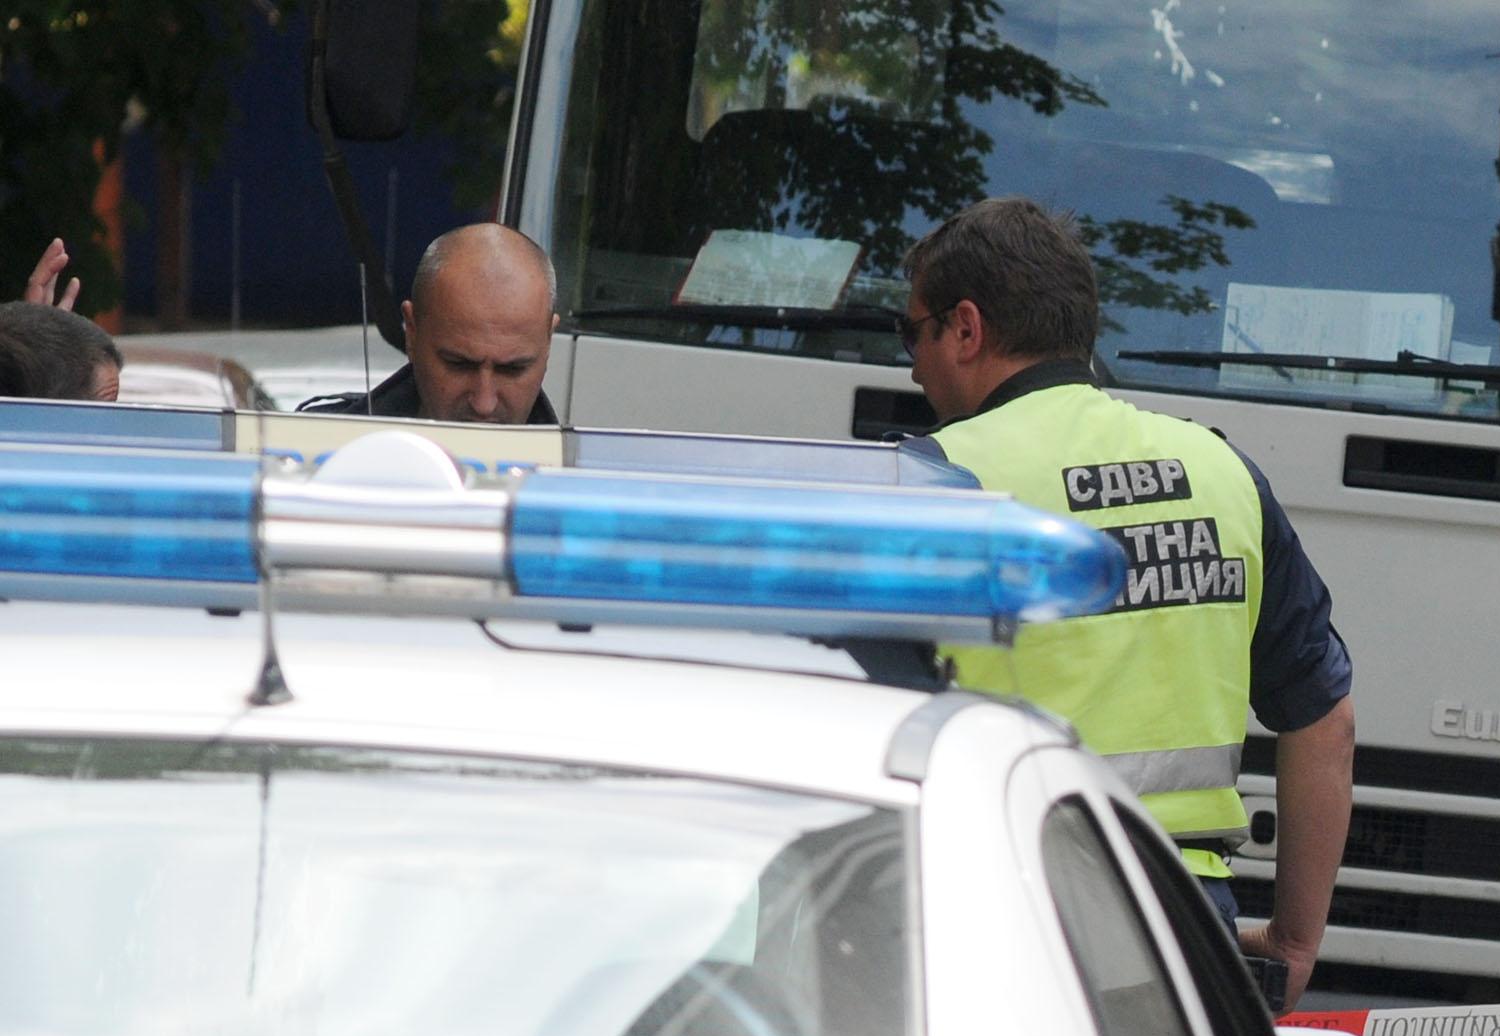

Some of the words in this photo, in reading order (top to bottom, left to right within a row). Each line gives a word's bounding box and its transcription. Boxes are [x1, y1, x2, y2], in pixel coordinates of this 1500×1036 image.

[1066, 459, 1184, 507] СДВР
[1122, 520, 1218, 563] ТНА
[1114, 559, 1244, 607] ИЦИЯ
